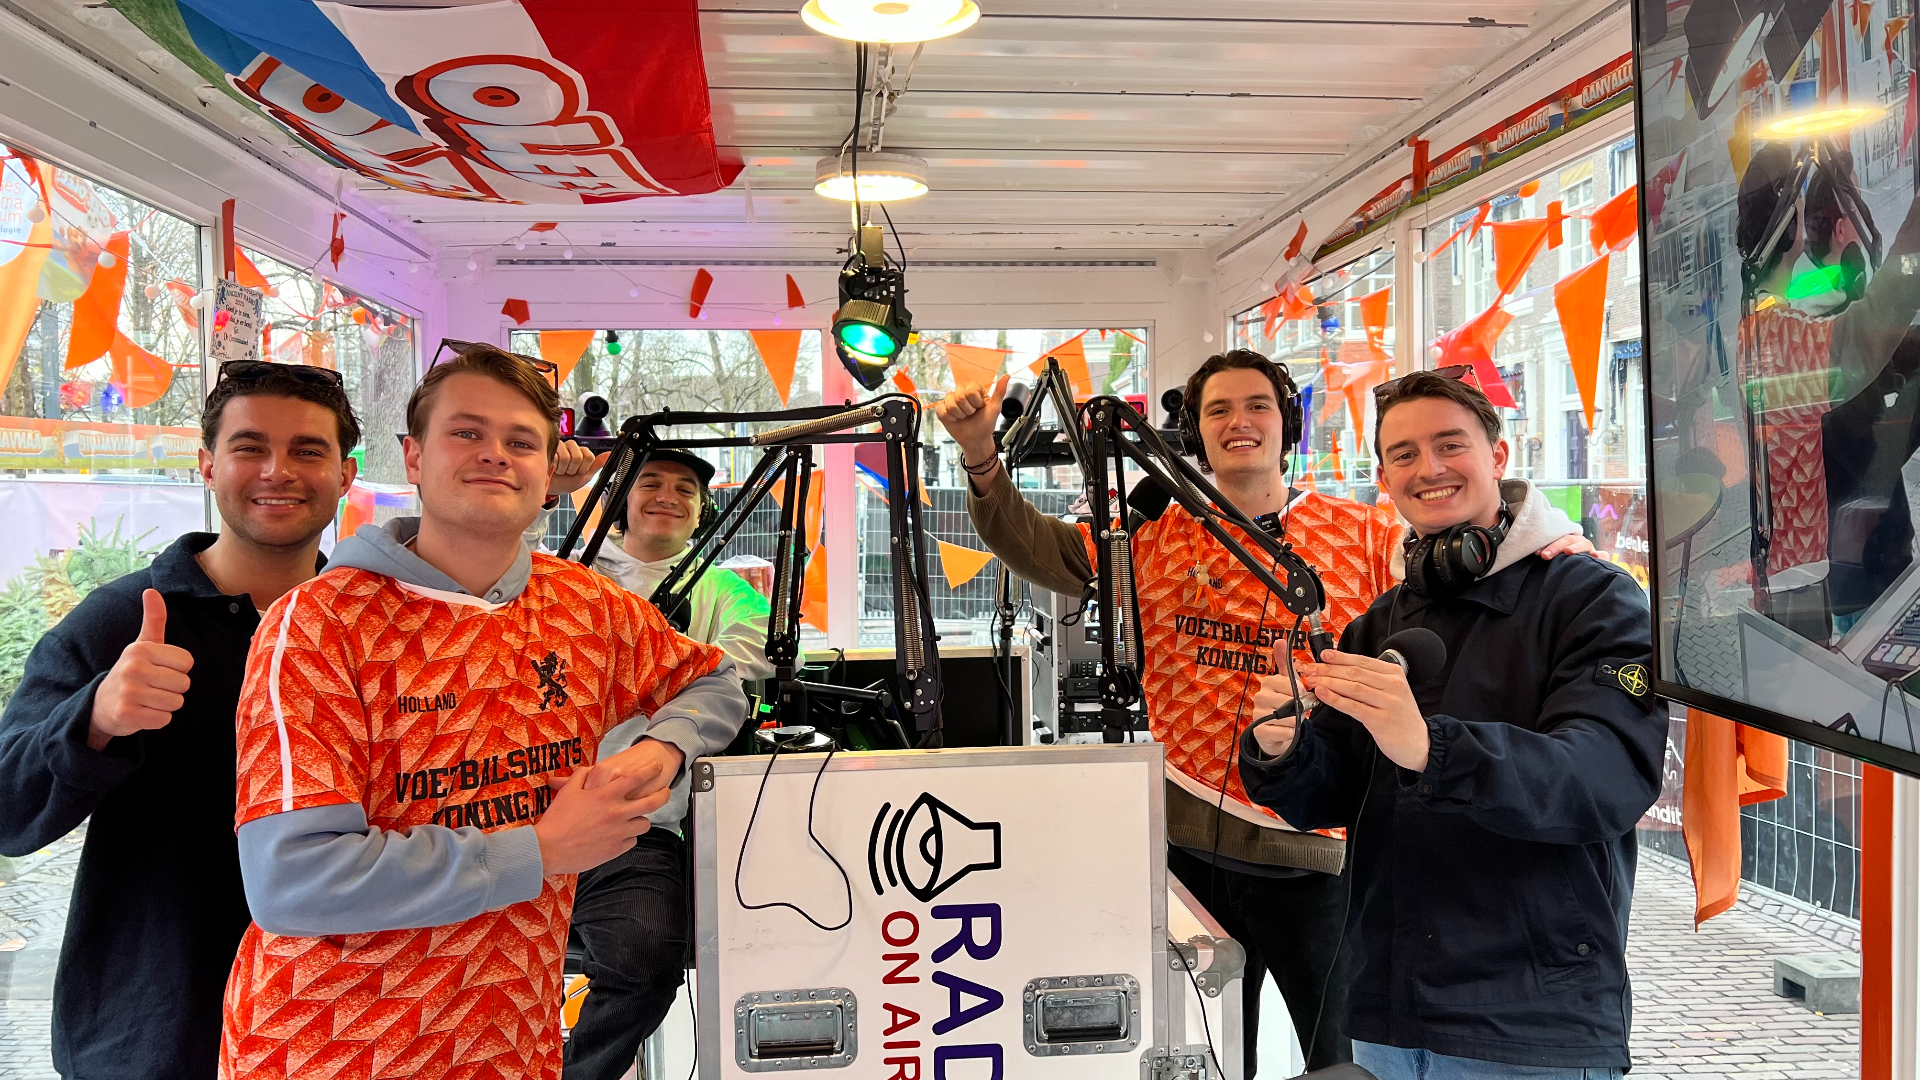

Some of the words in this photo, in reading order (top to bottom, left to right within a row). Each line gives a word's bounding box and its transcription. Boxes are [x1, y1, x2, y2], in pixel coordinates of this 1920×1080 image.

[1497, 107, 1550, 152] AANVALLUH!
[397, 692, 457, 714] HOLLAND
[395, 737, 582, 804] VOETBALSHIRTS
[882, 911, 920, 984] ON
[882, 1003, 921, 1080] AIR
